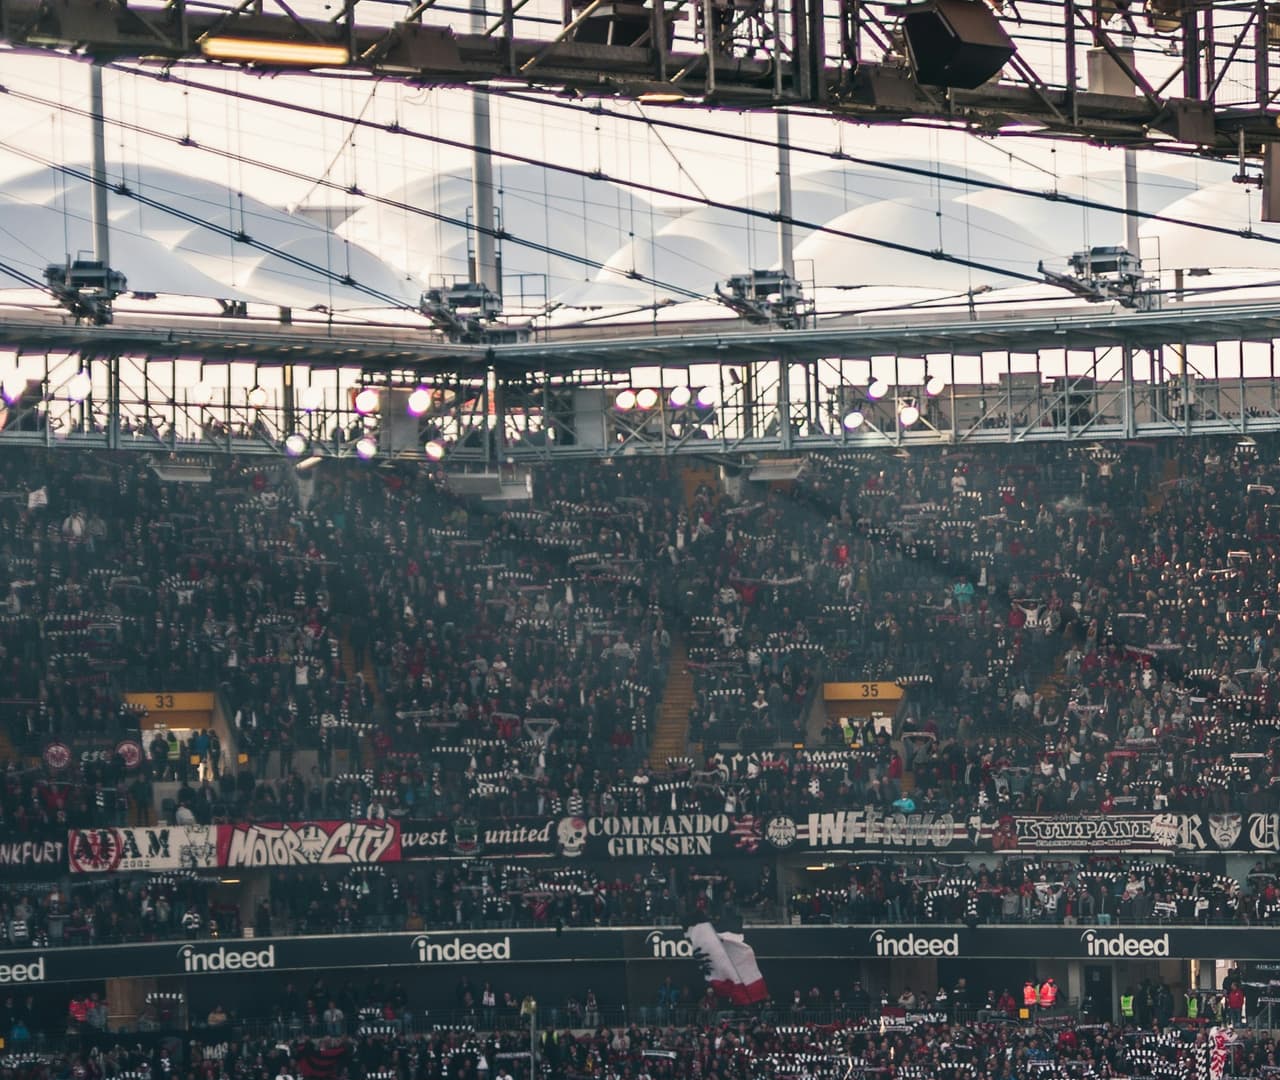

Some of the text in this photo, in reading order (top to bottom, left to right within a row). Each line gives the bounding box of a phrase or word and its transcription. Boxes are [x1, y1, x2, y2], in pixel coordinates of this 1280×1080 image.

[155, 694, 174, 708] 33
[860, 684, 880, 698] 35
[401, 821, 554, 846] west united
[588, 814, 729, 836] COMMANDO
[808, 810, 954, 847] INFERNO
[608, 835, 712, 857] GIESSEN
[418, 936, 511, 963] indeed
[876, 932, 960, 957] indeed
[1087, 932, 1170, 957] indeed
[184, 944, 275, 972] indeed
